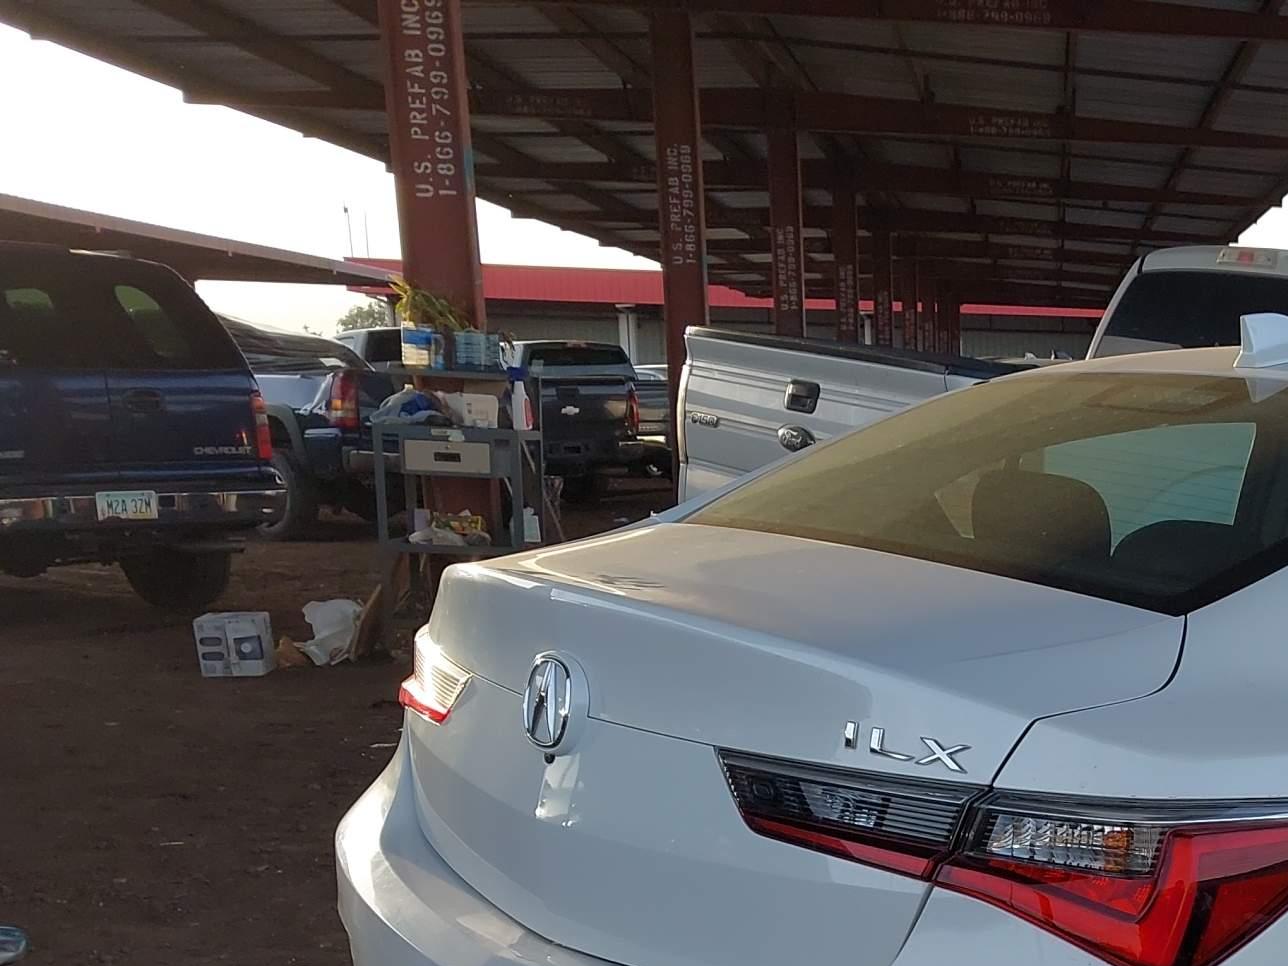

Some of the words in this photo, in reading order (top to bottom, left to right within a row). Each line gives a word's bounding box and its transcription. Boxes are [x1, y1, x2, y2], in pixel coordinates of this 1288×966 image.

[403, 49, 430, 140] PREFAB
[413, 154, 434, 197] U.S.
[668, 176, 682, 231] PREFAB
[844, 720, 973, 774] ILX
